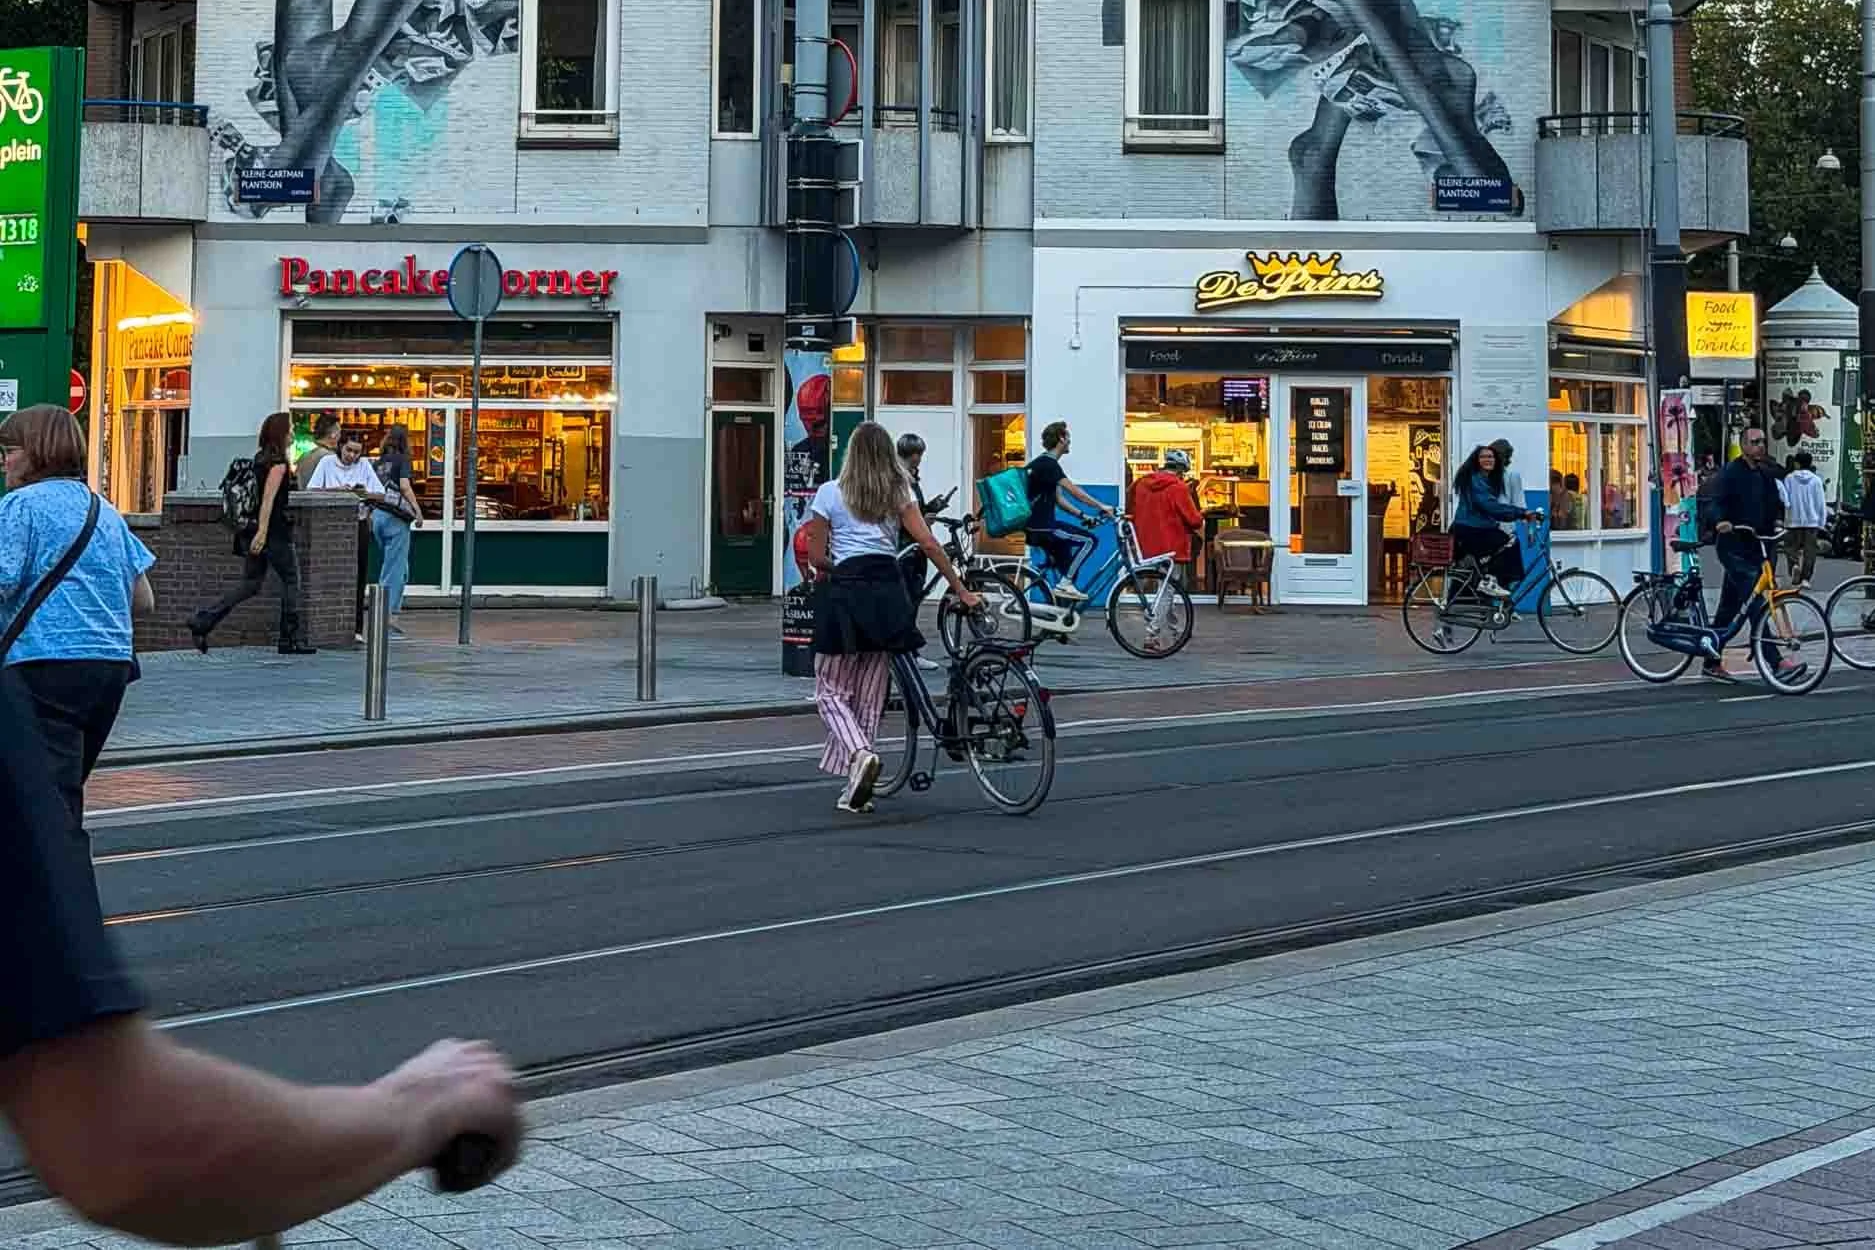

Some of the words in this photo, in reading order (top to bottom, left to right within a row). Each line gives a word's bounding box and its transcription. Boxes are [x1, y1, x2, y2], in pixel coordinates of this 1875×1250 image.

[0, 139, 41, 169] plein
[240, 169, 305, 179] KLEINE-GARTMAN
[240, 180, 284, 190] PLANTSOEN
[1438, 178, 1502, 187] KLEINE-GARTMAN
[1438, 189, 1480, 198] PLANTSOEN
[279, 254, 449, 296] Pancake
[492, 265, 620, 296] orner
[1197, 270, 1259, 300] De
[1260, 264, 1383, 300] Prins
[1704, 299, 1737, 313] Food
[128, 332, 164, 361] Pancake
[166, 327, 193, 359] Corne
[1695, 335, 1750, 352] Drinks
[1149, 350, 1182, 362] Food
[1381, 351, 1425, 364] Drinks
